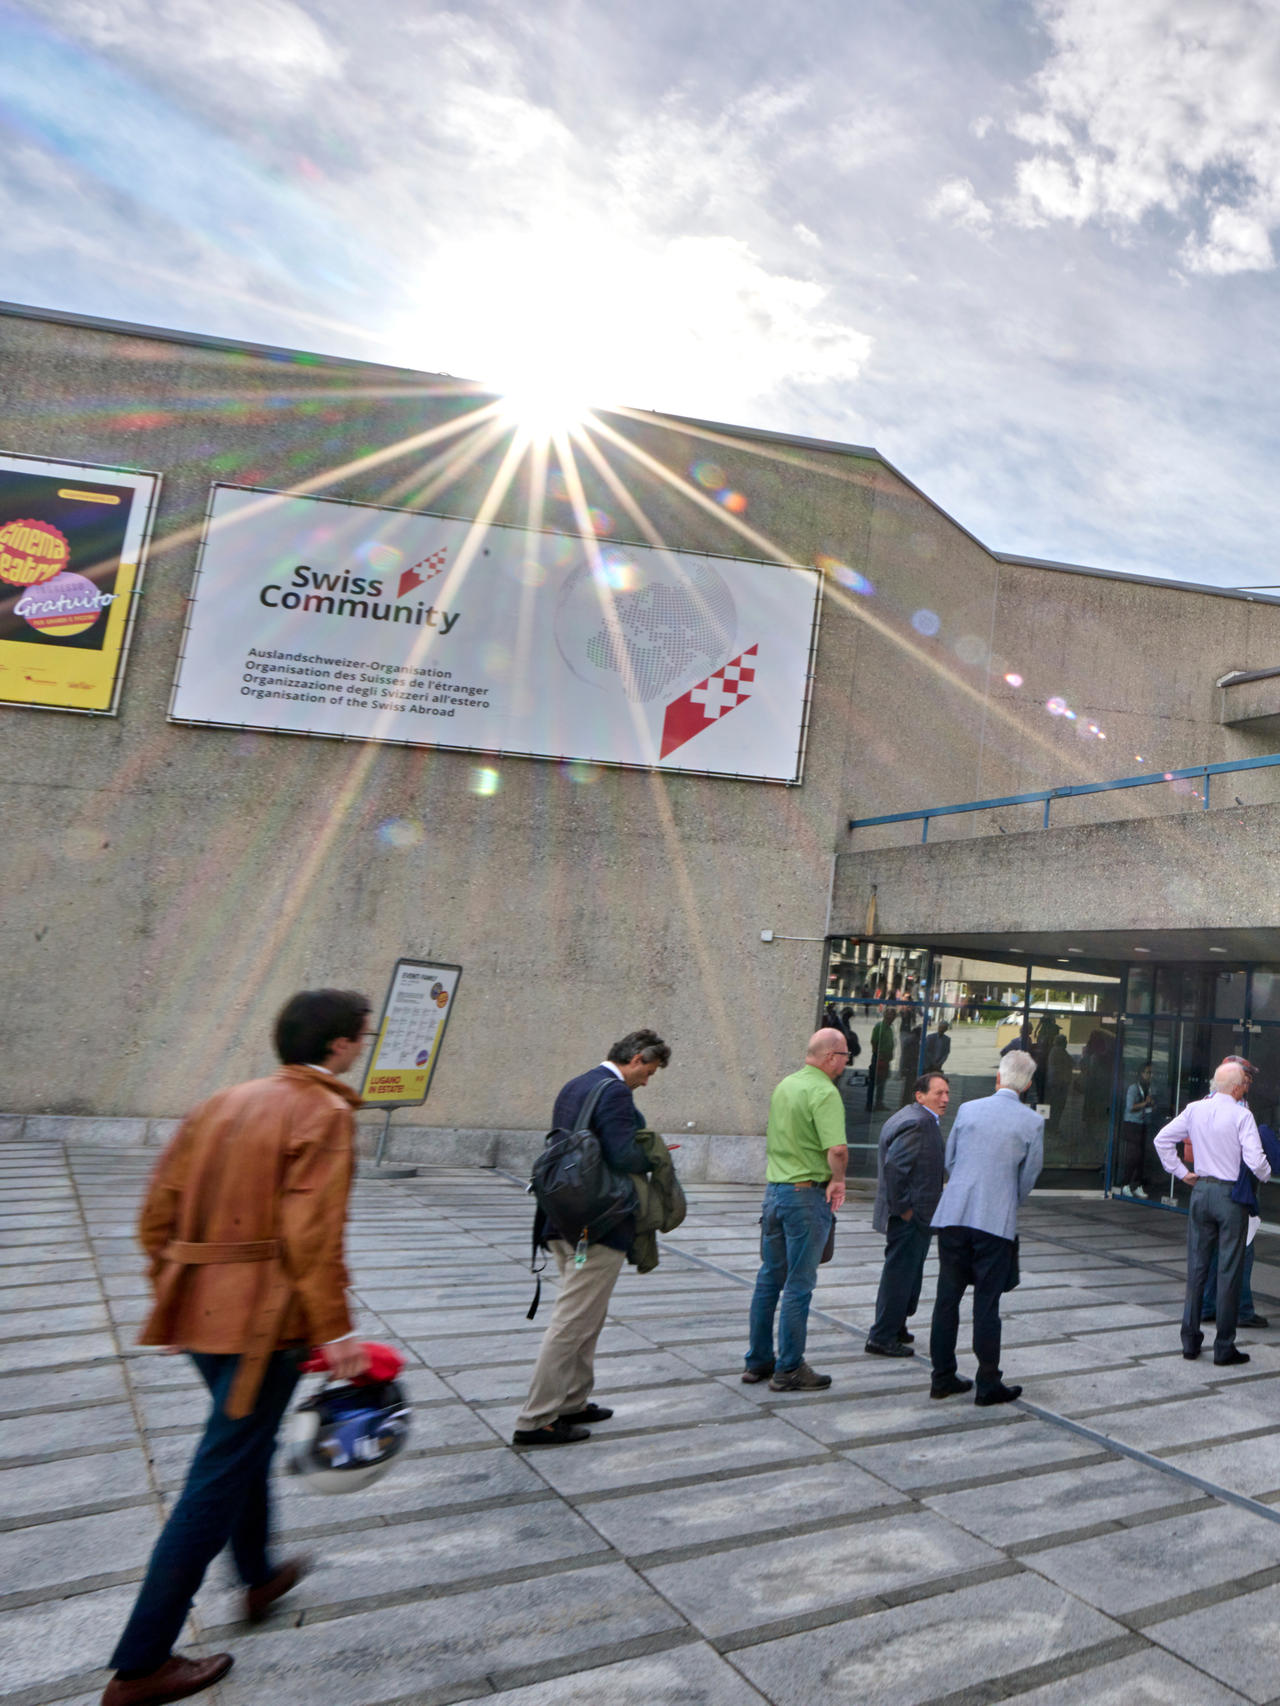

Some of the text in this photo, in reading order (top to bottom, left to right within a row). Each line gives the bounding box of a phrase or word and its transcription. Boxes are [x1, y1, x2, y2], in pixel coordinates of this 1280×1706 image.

[291, 565, 384, 598] Swiss
[14, 590, 120, 616] Gratuito
[259, 584, 461, 635] Community
[245, 660, 331, 678] Organisation
[334, 670, 356, 681] des
[360, 673, 405, 687] Suisses
[409, 679, 425, 689] de
[248, 647, 452, 679] Auslandschweizer-Organisation
[240, 686, 455, 718] Organisation of the Swiss Abroad
[243, 673, 343, 693] Organizzazione
[346, 685, 378, 698] degli
[381, 688, 429, 702] Svizzeri
